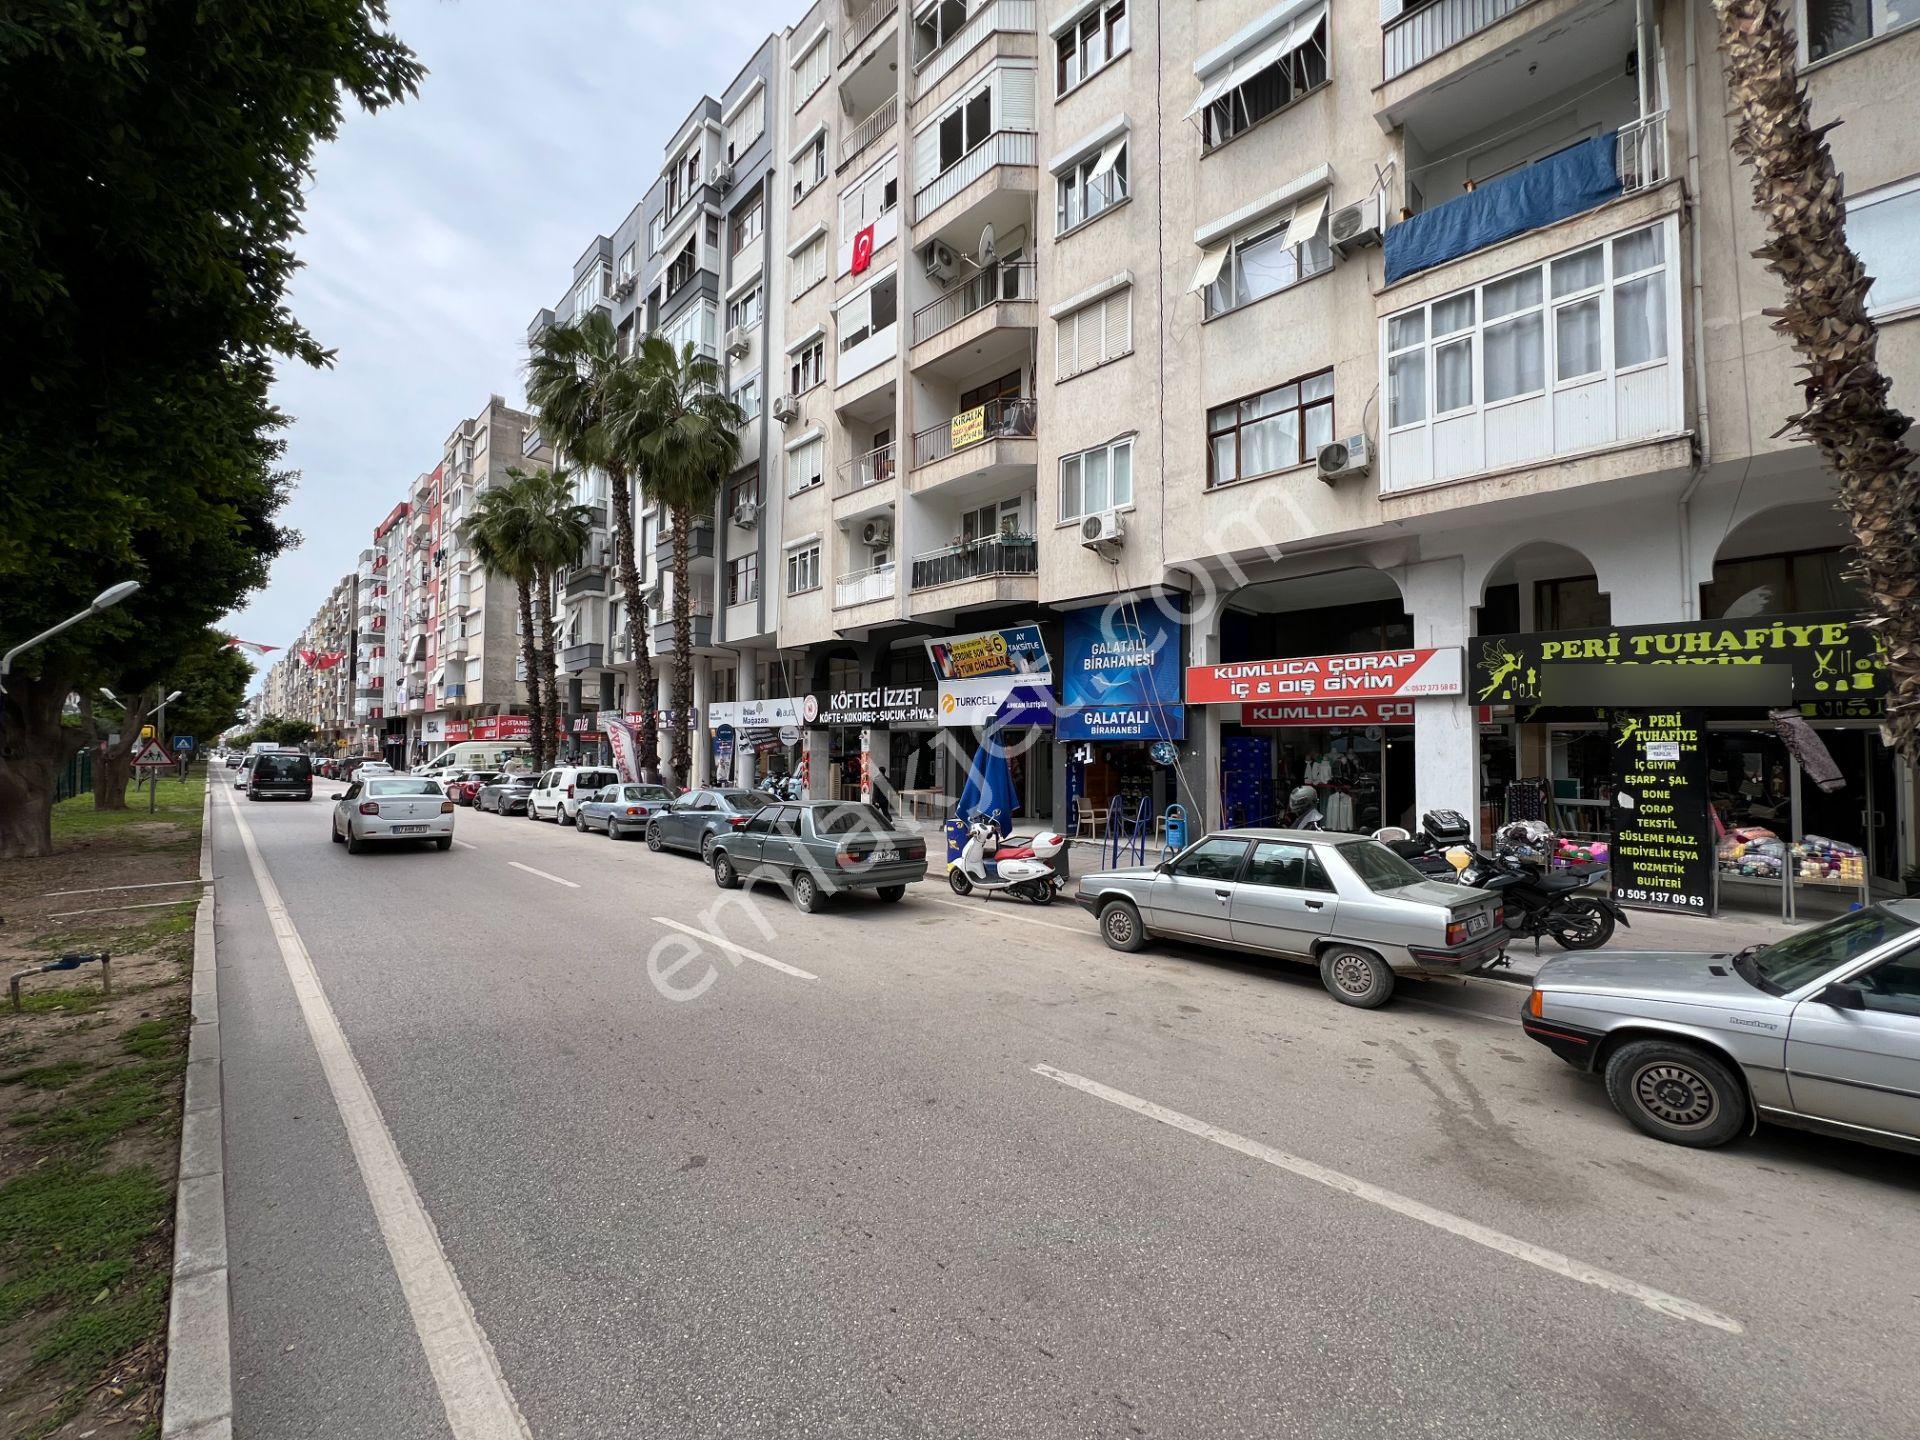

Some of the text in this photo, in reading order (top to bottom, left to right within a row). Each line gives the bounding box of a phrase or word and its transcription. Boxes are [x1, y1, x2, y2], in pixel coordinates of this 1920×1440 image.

[992, 637, 1003, 652] 6
[1008, 642, 1040, 651] TAKSİTLE
[1091, 638, 1147, 655] GALATALI
[1541, 622, 1849, 660] PERİ TUHAFİYE
[1084, 650, 1155, 670] BİRAHANESİ
[1214, 653, 1416, 679] KUMLUCA ÇORAP
[1230, 672, 1394, 699] İÇ & DIŞ GİYİM
[830, 686, 922, 710] KÖFTECİ İZZET
[955, 696, 997, 706] TURKCELL
[1084, 710, 1149, 725] GALATALI
[1253, 705, 1368, 720] KUMLUCA
[1649, 712, 1681, 727] PERİ
[1091, 724, 1141, 735] BİRAHANESİ
[1635, 728, 1697, 741] TUHAFİYE
[1635, 759, 1645, 771] İÇ
[1625, 775, 1656, 785] EŞARP
[1669, 776, 1688, 786] ŞAL
[1642, 790, 1670, 799] BONE
[1640, 805, 1673, 814] ÇORAP
[1637, 818, 1677, 828] TEKSTİL
[1619, 830, 1698, 845] SÜSLEME MALZ.
[1619, 846, 1698, 861] HEDİYELİK EŞYA
[1633, 862, 1685, 873] KOZMETİK
[1637, 876, 1681, 888] BUJİTERİ
[1618, 889, 1704, 906] 0 505 137 09 63
